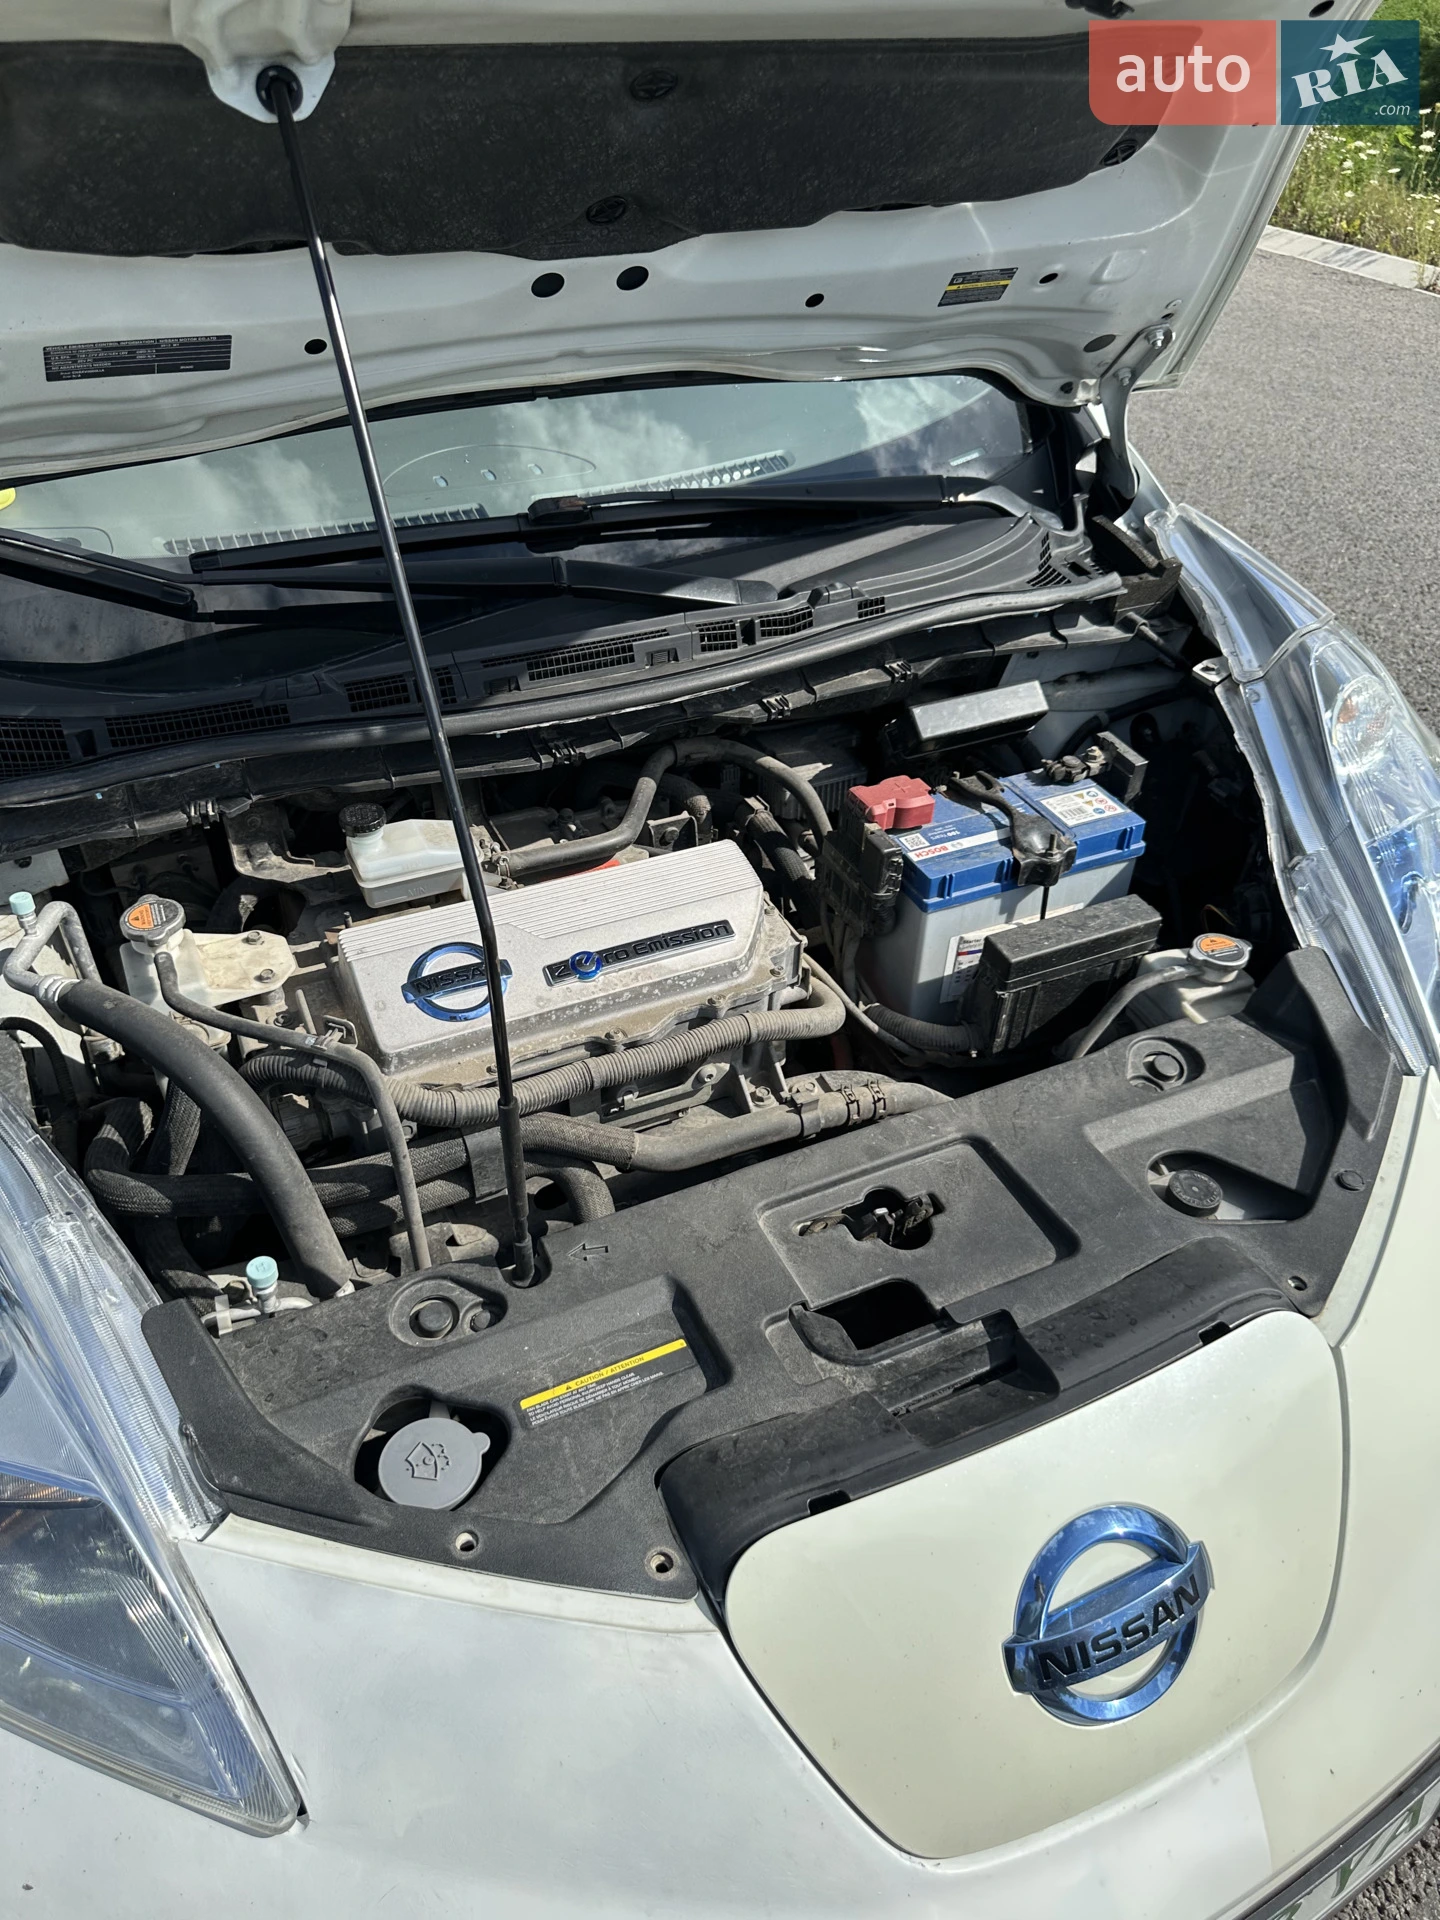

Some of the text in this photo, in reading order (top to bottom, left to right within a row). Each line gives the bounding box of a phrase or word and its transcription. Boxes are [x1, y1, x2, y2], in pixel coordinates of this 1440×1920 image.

[914, 845, 949, 858] BOSCH
[632, 924, 731, 955] Emission
[414, 966, 487, 993] NISSA
[575, 1371, 604, 1386] CAUTION
[609, 1356, 644, 1373] ATTENTION
[1037, 1573, 1201, 1683] NISSAN
